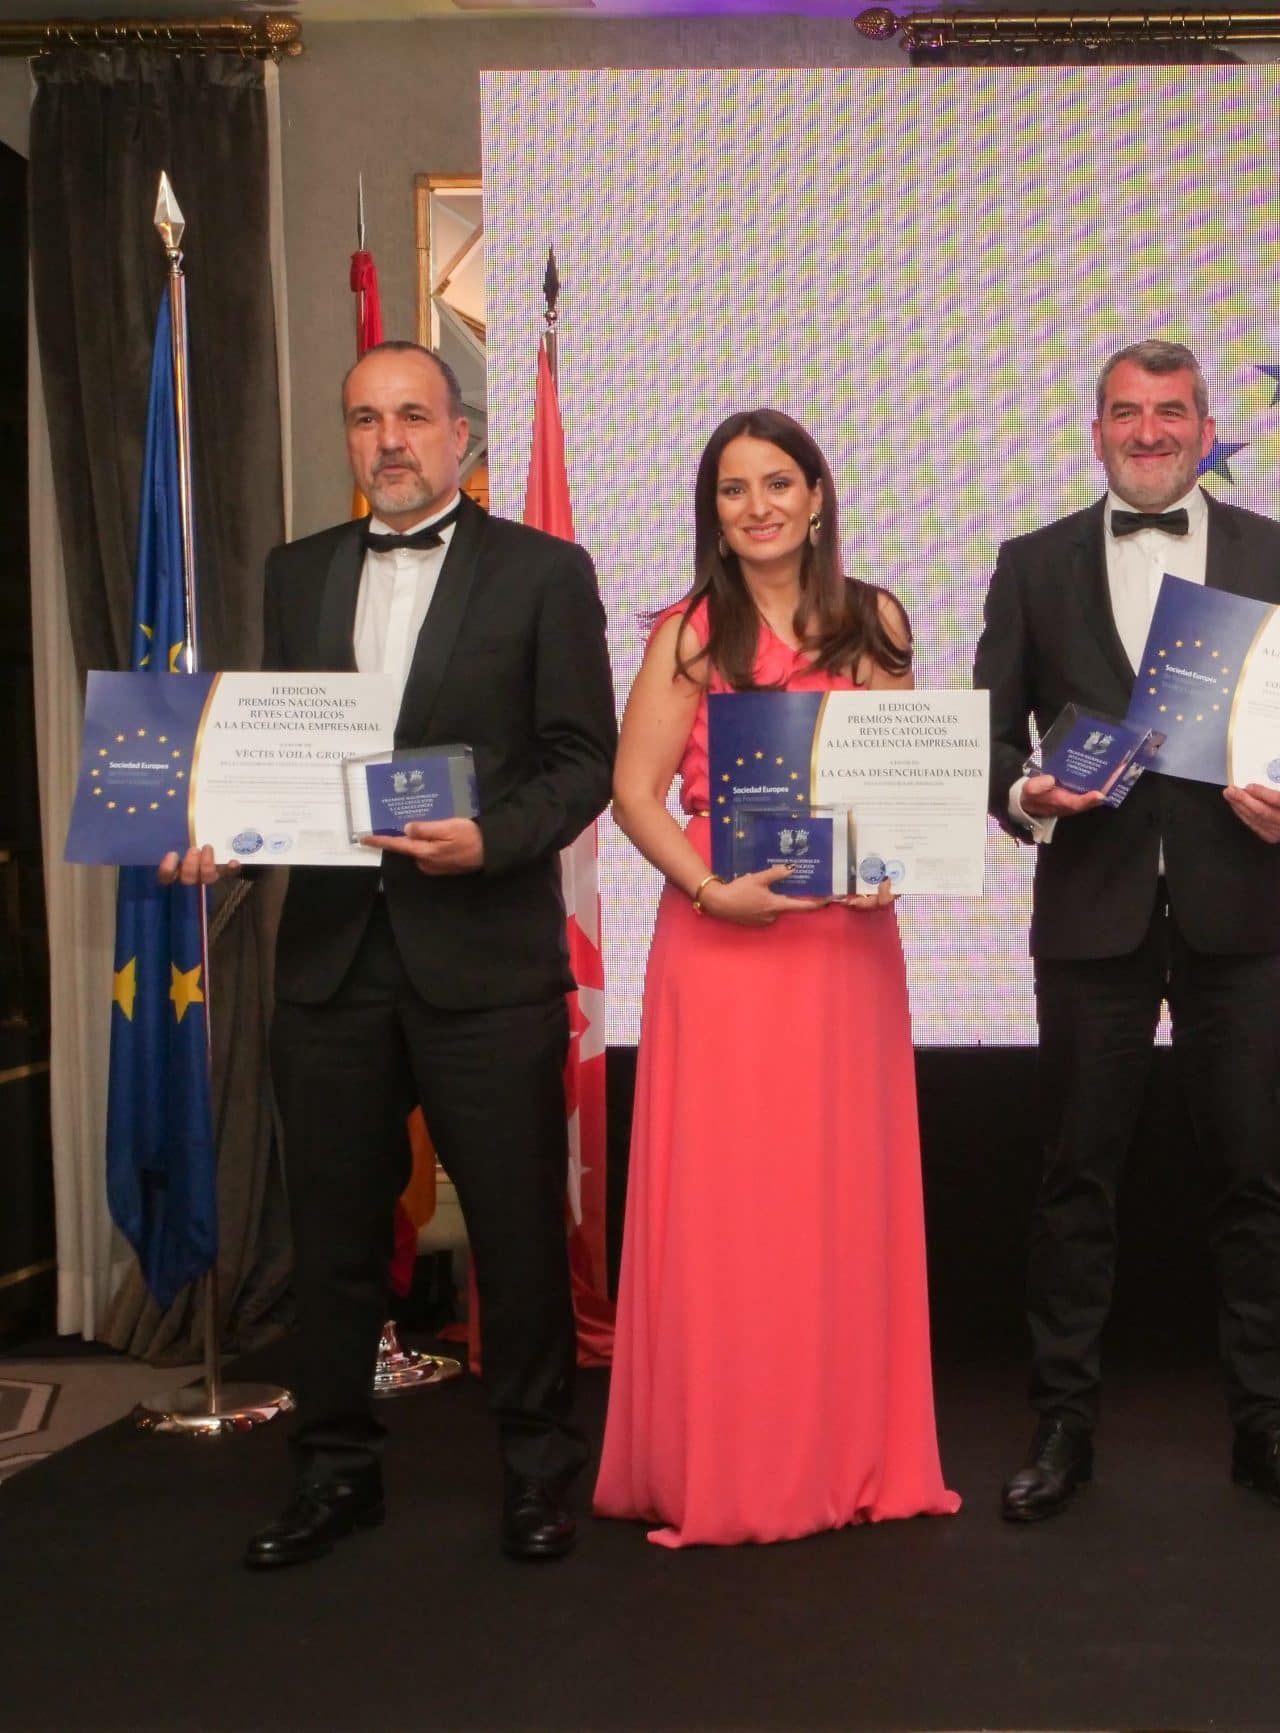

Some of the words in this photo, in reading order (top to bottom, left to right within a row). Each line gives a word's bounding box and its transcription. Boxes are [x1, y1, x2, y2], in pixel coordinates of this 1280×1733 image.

[238, 698, 286, 707] PREMIOS
[288, 698, 357, 708] NACIONALES
[879, 703, 886, 712] II
[250, 710, 282, 718] REYES
[848, 715, 893, 724] PREMIOS
[895, 715, 958, 724] NACIONALES
[224, 721, 238, 730] LA
[241, 721, 305, 731] EXCELENCIA
[308, 722, 381, 732] EMPRESARIAL
[859, 727, 890, 736] REYES
[826, 740, 834, 748] A
[836, 740, 850, 748] LA
[851, 739, 913, 748] EXCELENCIA
[914, 739, 980, 748] EMPRESARIAL
[108, 761, 140, 769] Sociedad
[820, 768, 834, 778] LA
[837, 768, 866, 777] CASA
[869, 768, 950, 778] DESENCHUFADA
[733, 786, 762, 794] Sociedad
[762, 786, 789, 794] Europea
